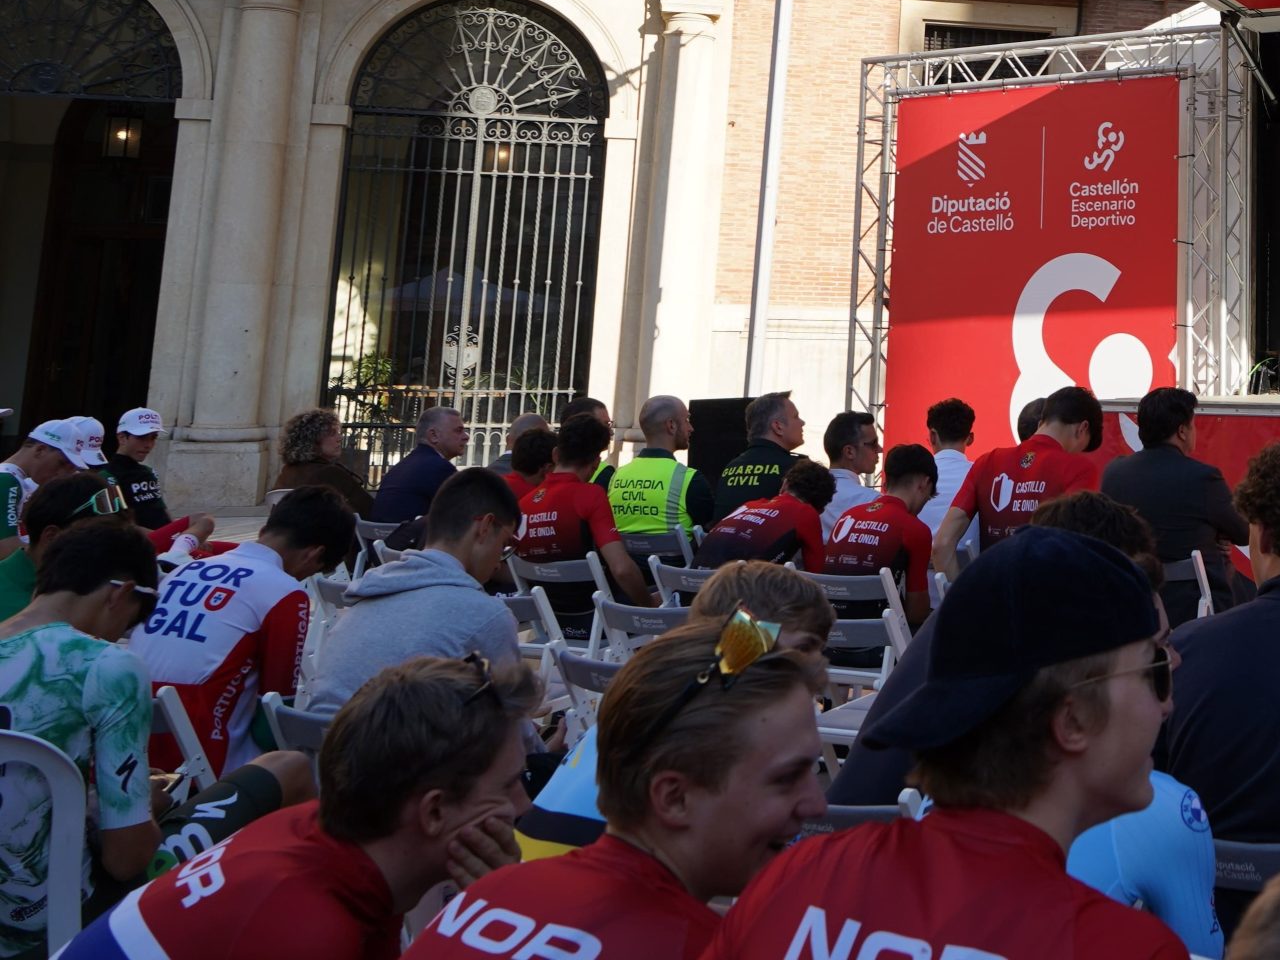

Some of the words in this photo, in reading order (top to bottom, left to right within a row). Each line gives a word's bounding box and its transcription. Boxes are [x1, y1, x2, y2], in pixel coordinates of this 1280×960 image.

[1069, 178, 1139, 197] Castellón
[931, 191, 1011, 215] Diputació
[1071, 197, 1136, 213] Escenario
[927, 216, 948, 234] de
[949, 211, 1014, 233] Castelló
[1070, 213, 1136, 230] Deportivo
[721, 464, 781, 477] GUARDIA
[613, 479, 664, 491] GUARDIA
[727, 475, 760, 486] CIVIL
[1015, 481, 1046, 494] CASTILLO
[622, 491, 647, 502] CIVIL
[8, 486, 19, 527] KOMETA
[612, 503, 659, 516] TRÁFICO
[1012, 500, 1021, 512] DE
[529, 511, 557, 524] CASTILLO
[742, 514, 765, 526] ONDA
[529, 529, 537, 538] DE
[537, 526, 556, 537] ONDA
[854, 520, 889, 532] CASTILLO
[848, 533, 858, 543] DE
[858, 534, 880, 546] ONDA
[175, 561, 254, 588] POR
[144, 607, 208, 643] GAL
[291, 600, 308, 689] PORTUGAL
